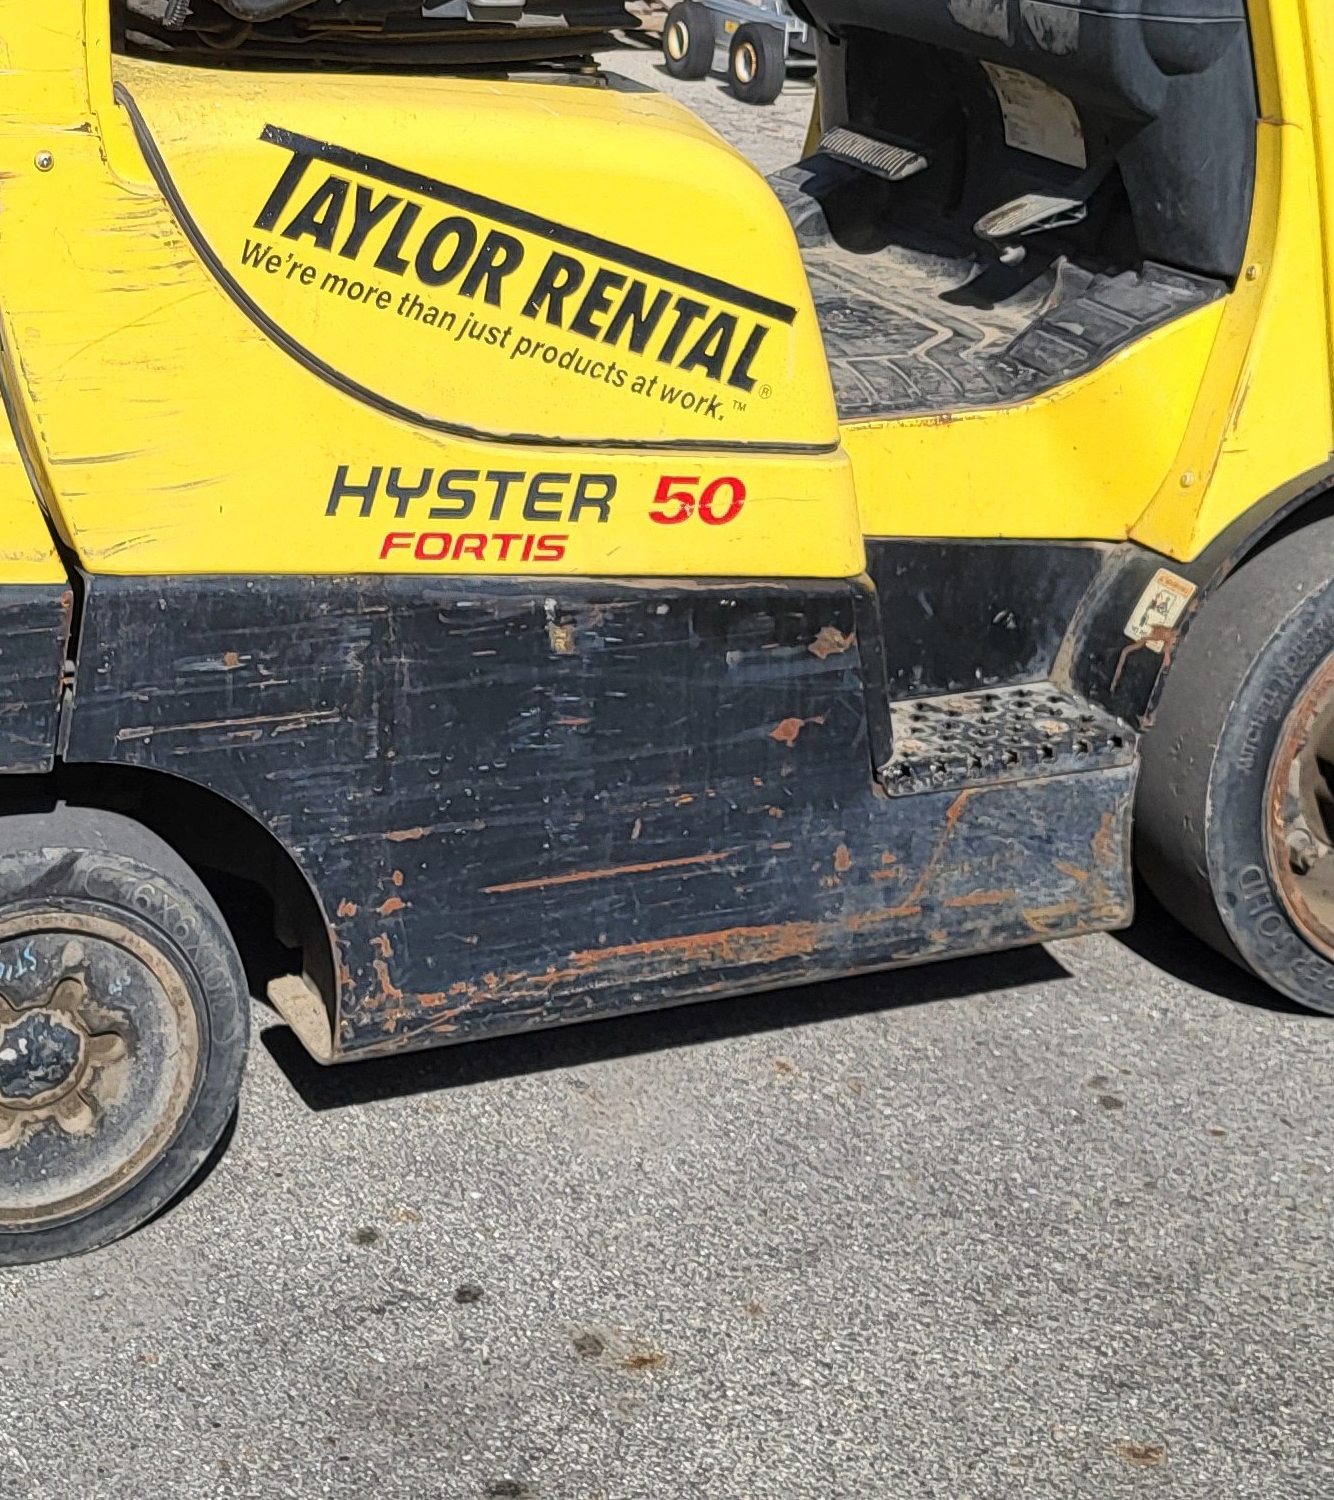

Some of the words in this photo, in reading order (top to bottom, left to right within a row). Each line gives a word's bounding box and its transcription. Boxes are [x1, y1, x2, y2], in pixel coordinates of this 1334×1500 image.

[253, 123, 525, 309] TAYLOR
[520, 250, 771, 393] RENTAL
[241, 238, 317, 286] We're
[320, 272, 392, 310] more
[396, 292, 457, 332] than
[454, 312, 513, 349] just
[510, 334, 630, 388] products
[630, 372, 662, 398] at
[661, 382, 726, 421] work.
[324, 464, 618, 523] HYSTER
[647, 474, 748, 526] 50
[377, 531, 570, 562] FORTIS
